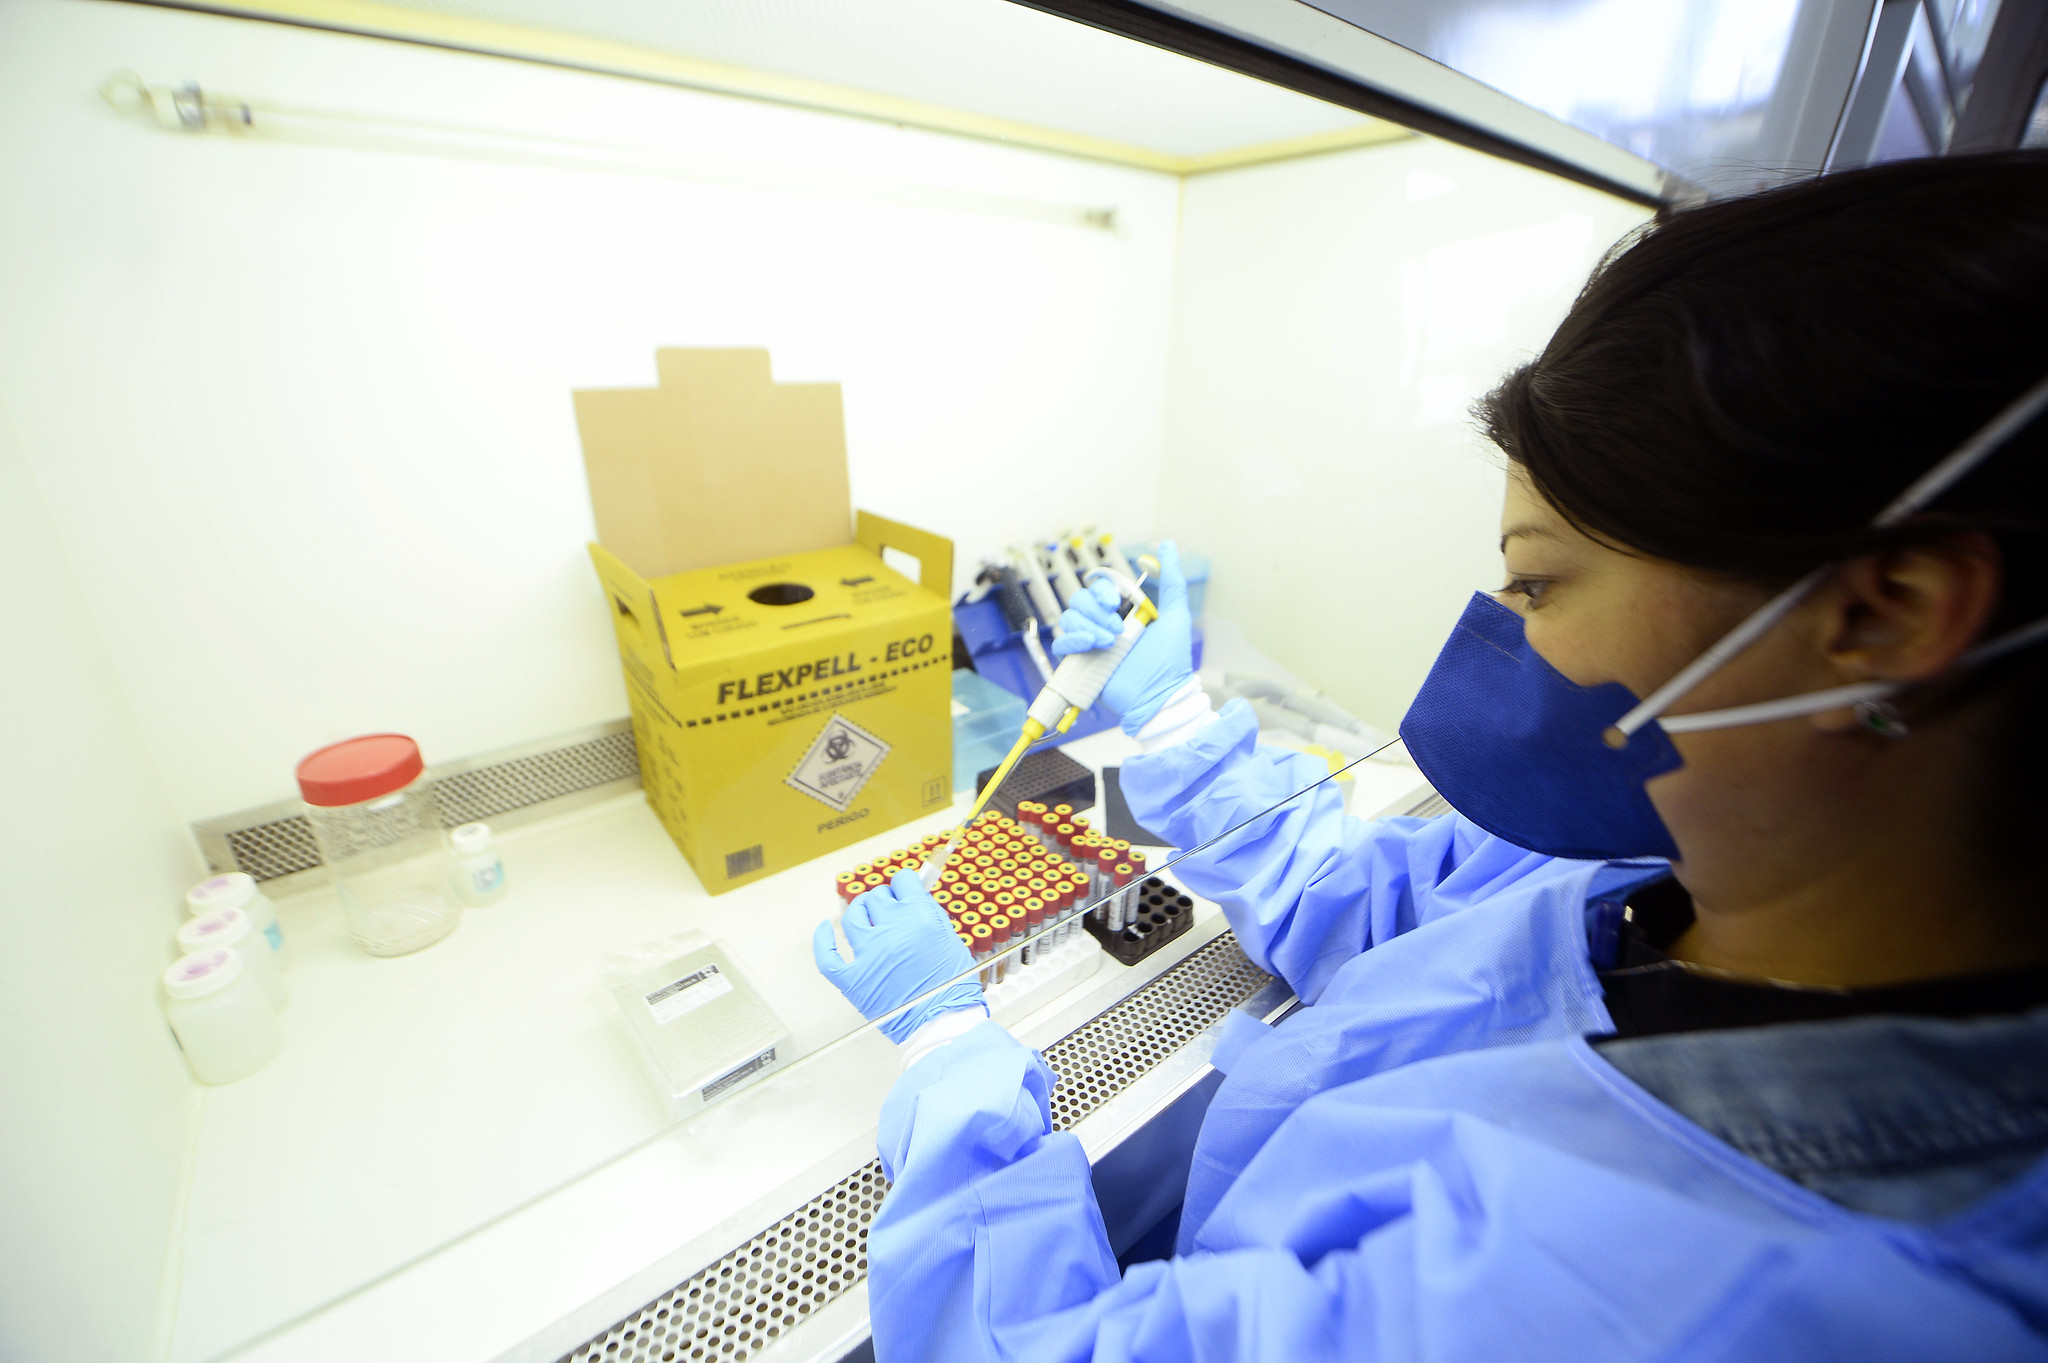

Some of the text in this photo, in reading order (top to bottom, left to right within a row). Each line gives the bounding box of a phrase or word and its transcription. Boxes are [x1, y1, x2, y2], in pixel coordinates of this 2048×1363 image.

[717, 652, 861, 704] FLEXPELL
[885, 633, 933, 663] ECO
[817, 808, 869, 833] PERIGO
